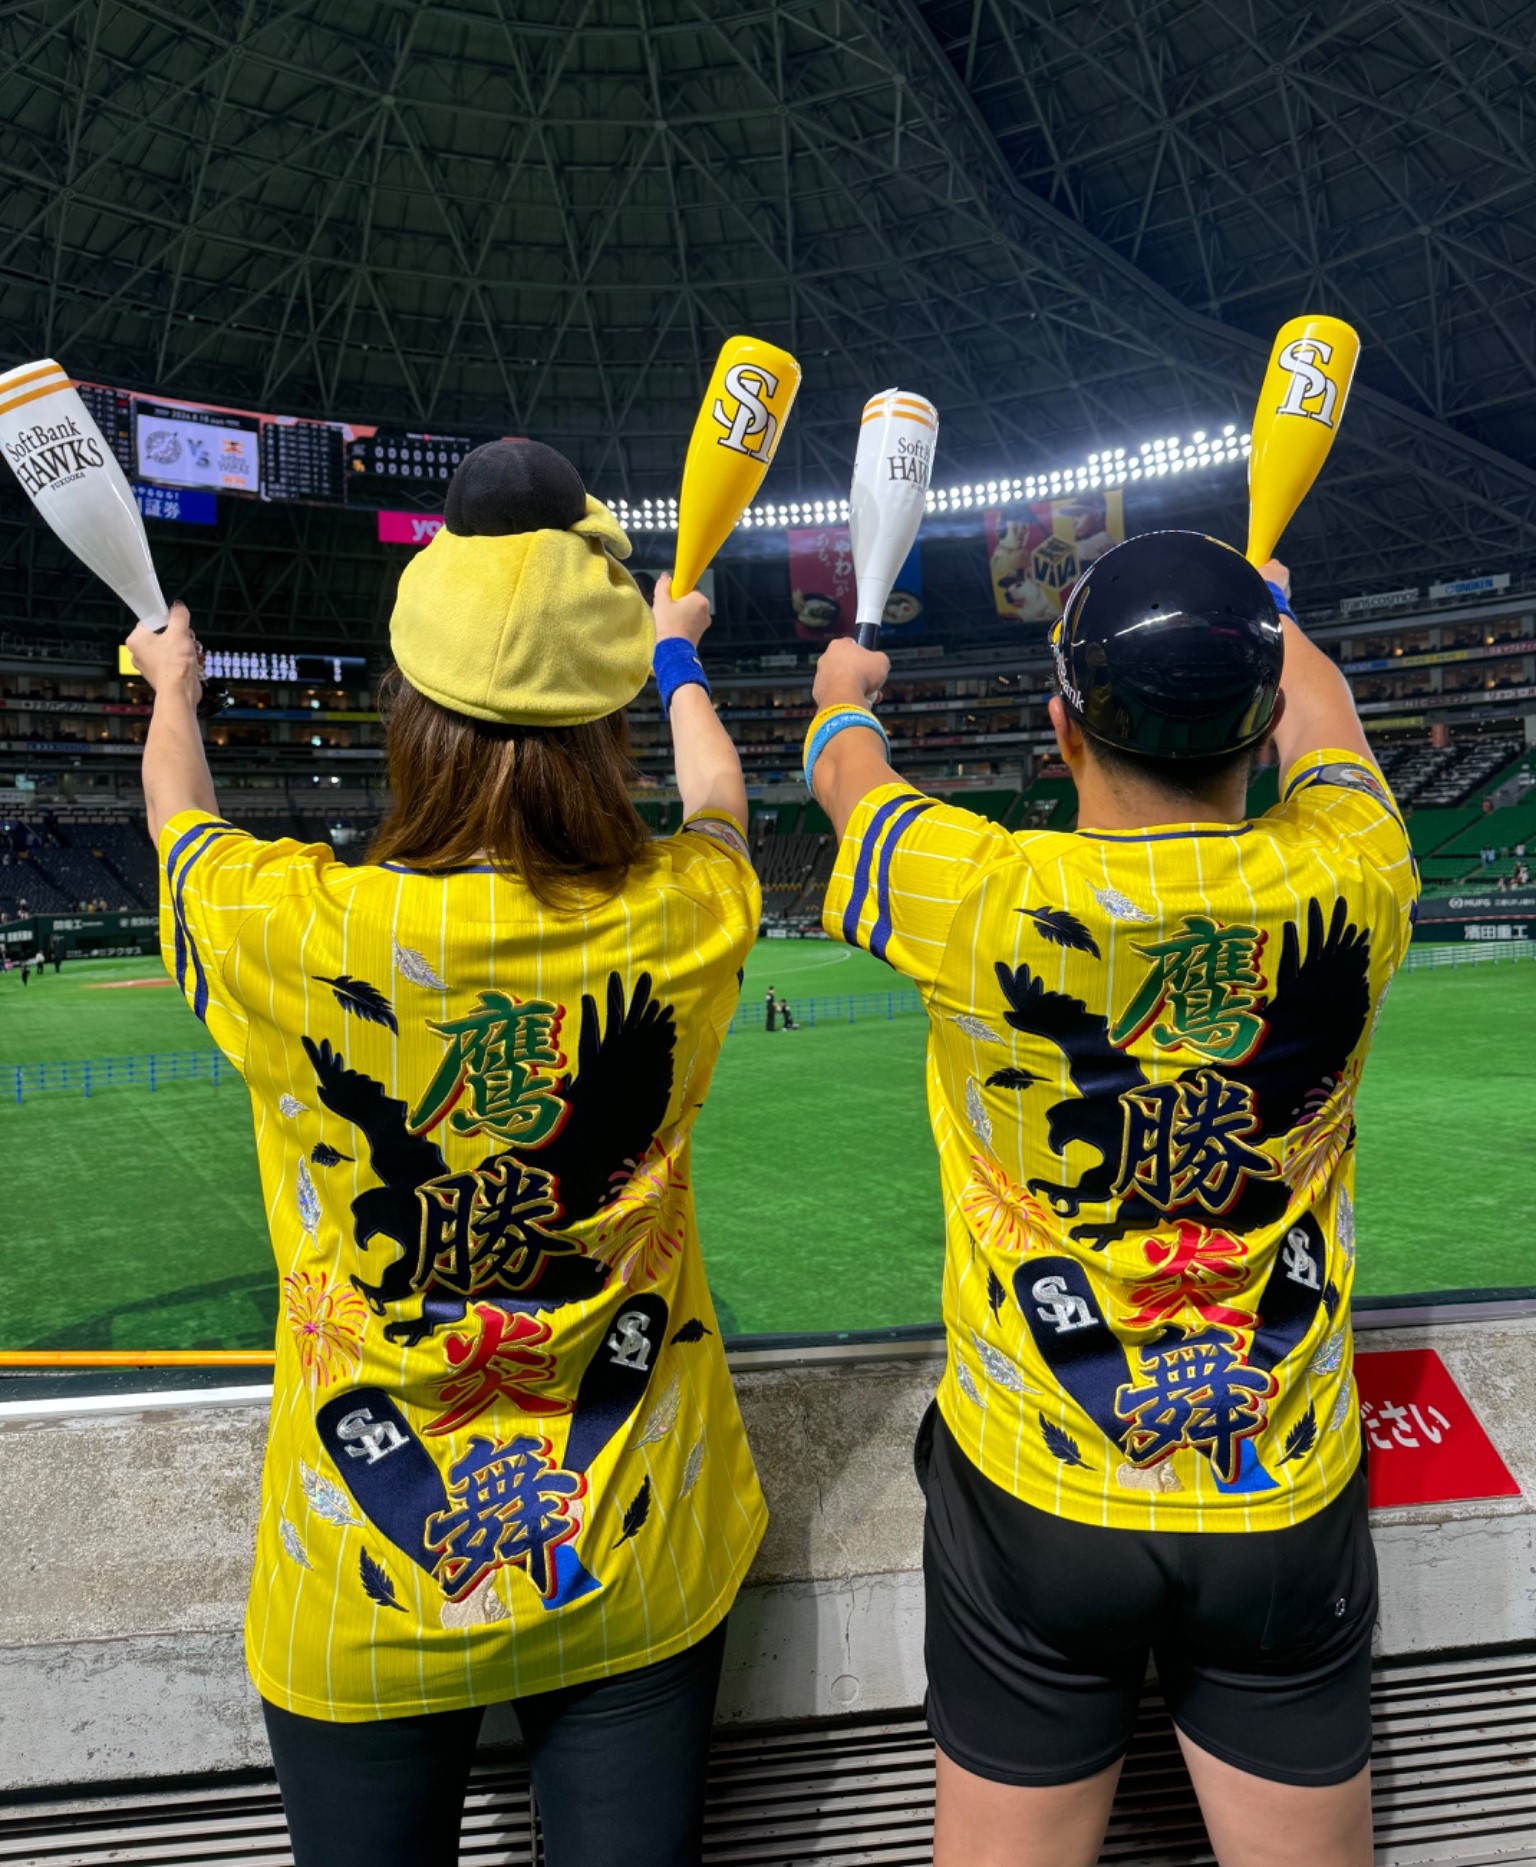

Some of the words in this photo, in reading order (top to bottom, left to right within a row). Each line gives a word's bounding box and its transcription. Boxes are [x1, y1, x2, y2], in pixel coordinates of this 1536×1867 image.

[6, 416, 81, 462] SoftBank
[17, 437, 104, 497] HAWKS
[50, 472, 86, 491] FUKUOKA
